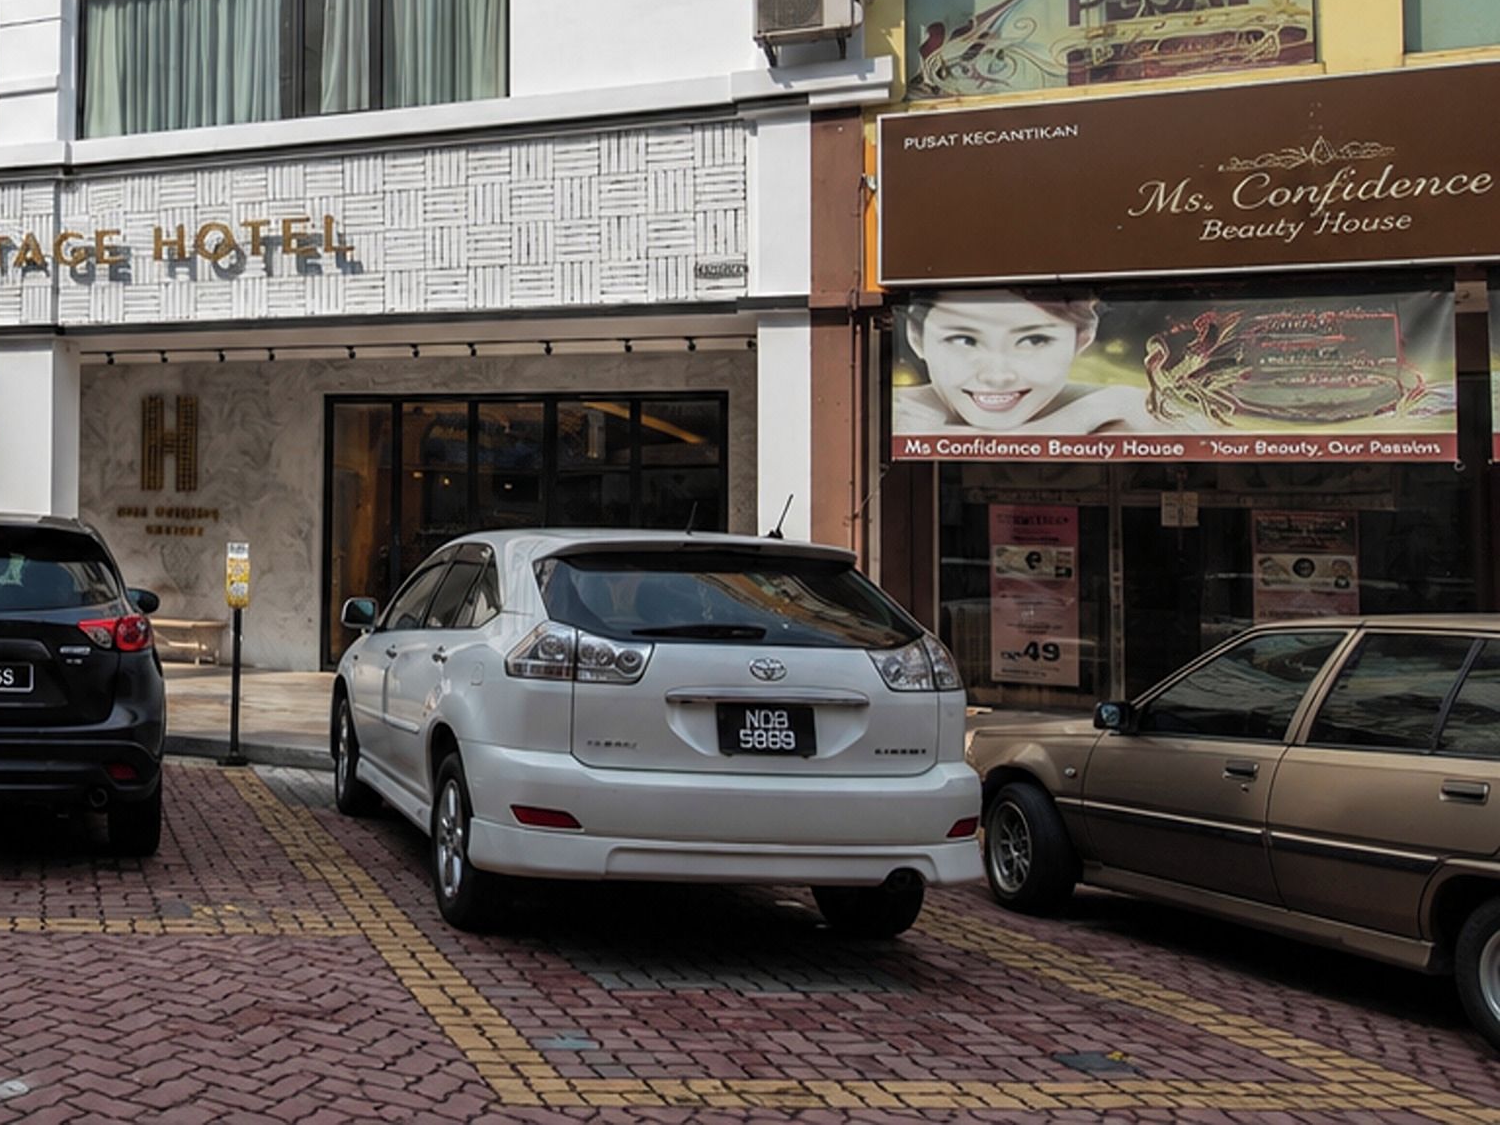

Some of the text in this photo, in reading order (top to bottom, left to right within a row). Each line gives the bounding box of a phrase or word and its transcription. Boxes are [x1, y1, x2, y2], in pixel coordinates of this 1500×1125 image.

[903, 124, 1079, 150] PUSAT KECANTIKAN
[1128, 164, 1494, 218] Ms. Confidence
[153, 213, 355, 262] HOTEL
[1199, 211, 1413, 243] Beauty House
[904, 439, 931, 455] Ms
[936, 439, 1042, 456] Confidence
[1048, 440, 1116, 460] Beauty
[1122, 440, 1185, 456] House
[1327, 440, 1364, 455] Our
